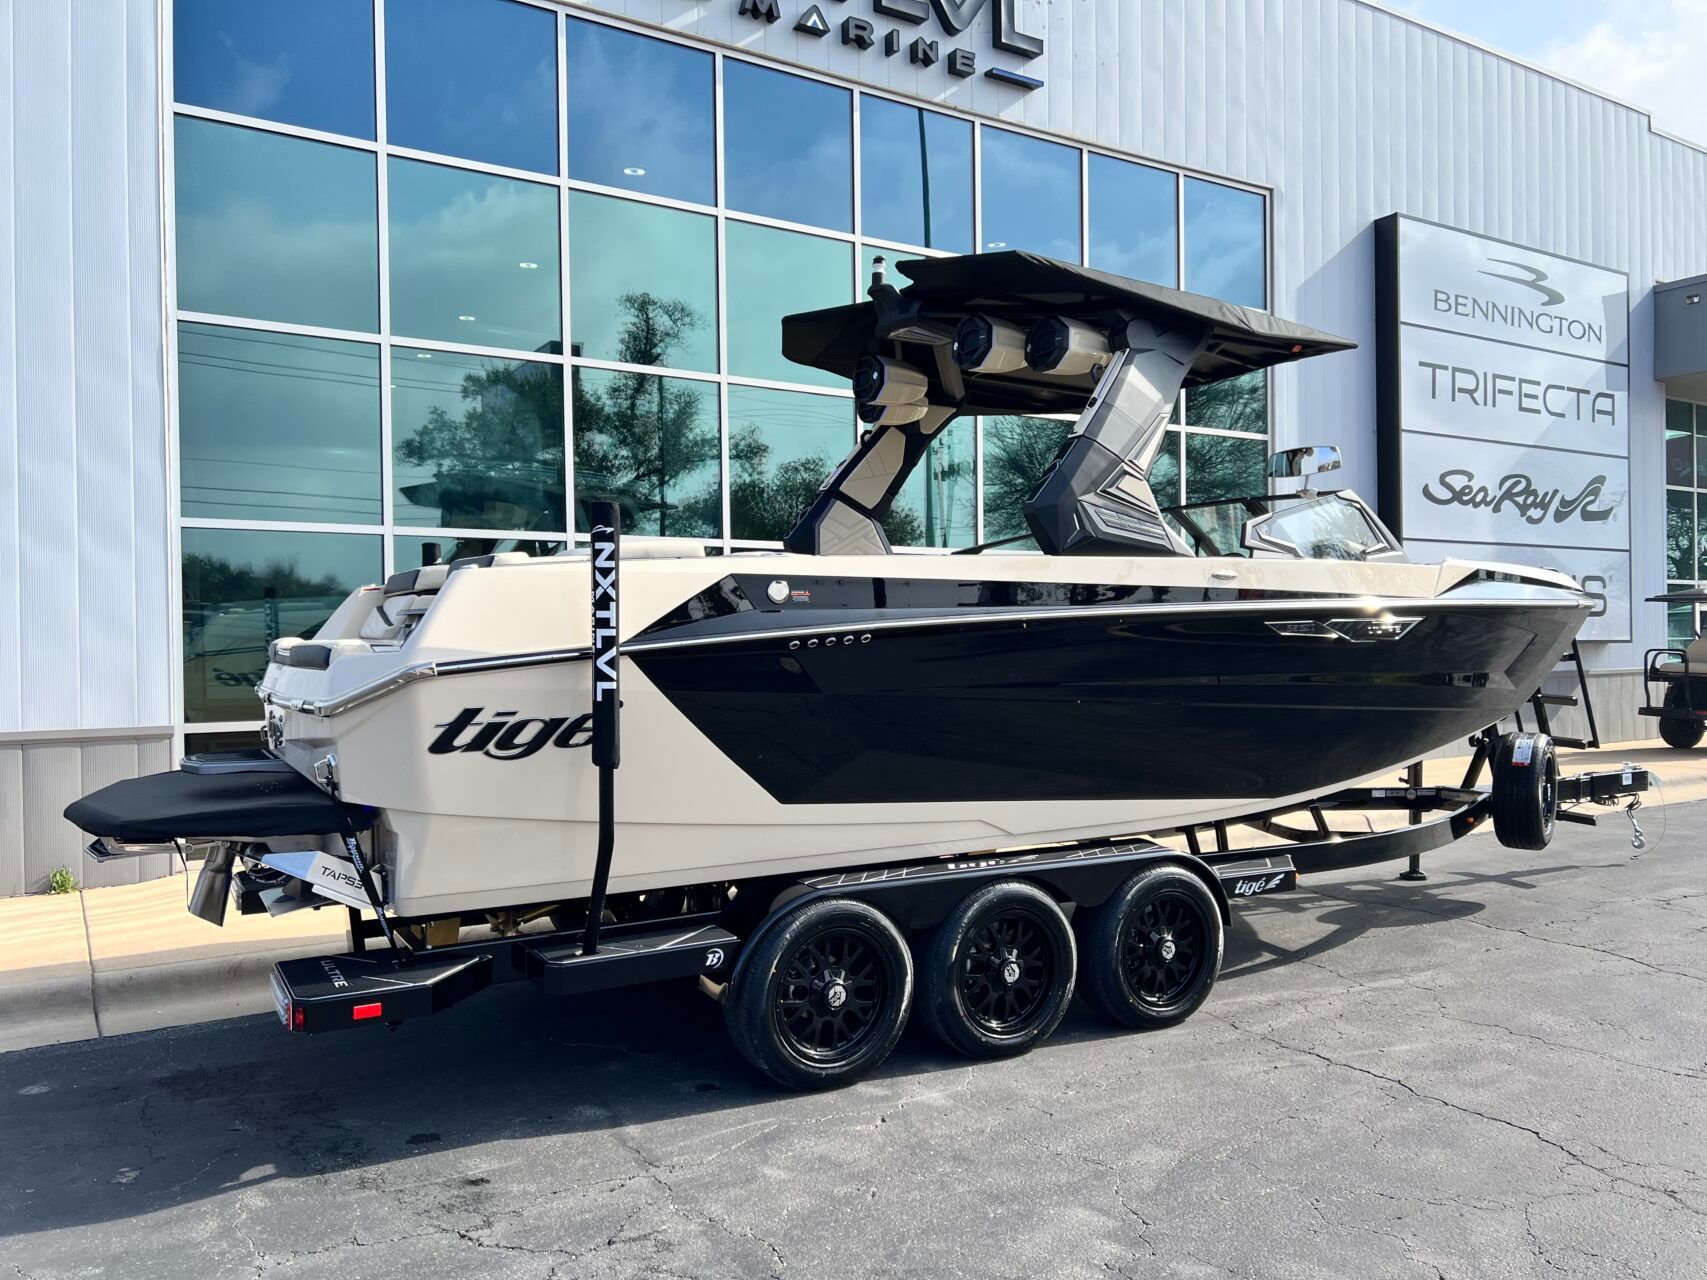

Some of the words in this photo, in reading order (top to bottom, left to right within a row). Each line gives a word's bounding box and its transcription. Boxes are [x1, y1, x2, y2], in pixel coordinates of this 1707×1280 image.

[738, 0, 976, 78] MARINE
[1433, 288, 1603, 344] BENNINGTON
[1418, 360, 1616, 427] TRIFECTA
[594, 541, 617, 702] NXTLVL
